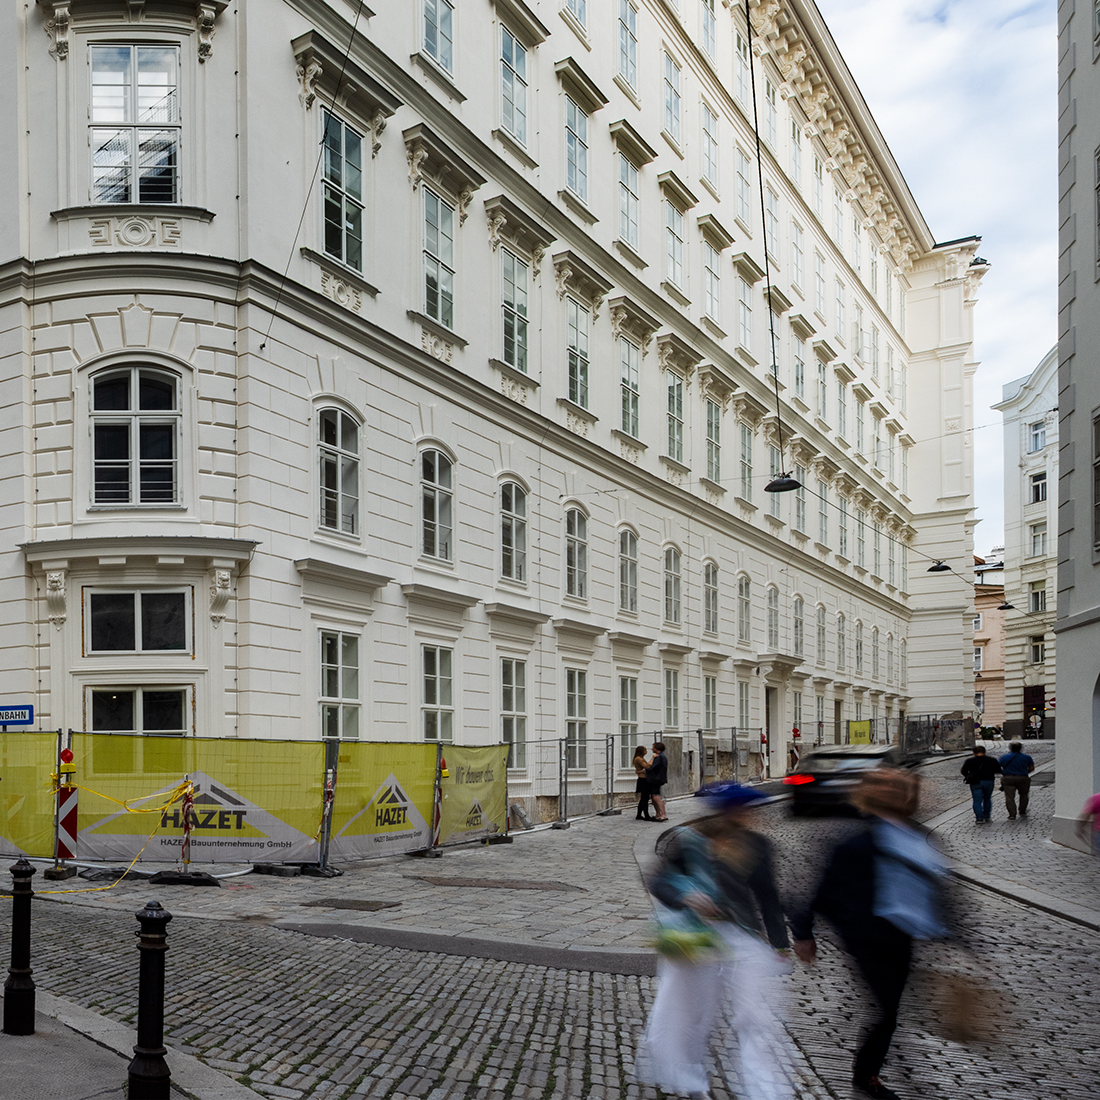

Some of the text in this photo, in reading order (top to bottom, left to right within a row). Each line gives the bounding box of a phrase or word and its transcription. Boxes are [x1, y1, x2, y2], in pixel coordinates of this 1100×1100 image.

[161, 809, 247, 829] HAZET
[375, 807, 408, 827] HAZET
[191, 840, 265, 848] Bauunternehmung
